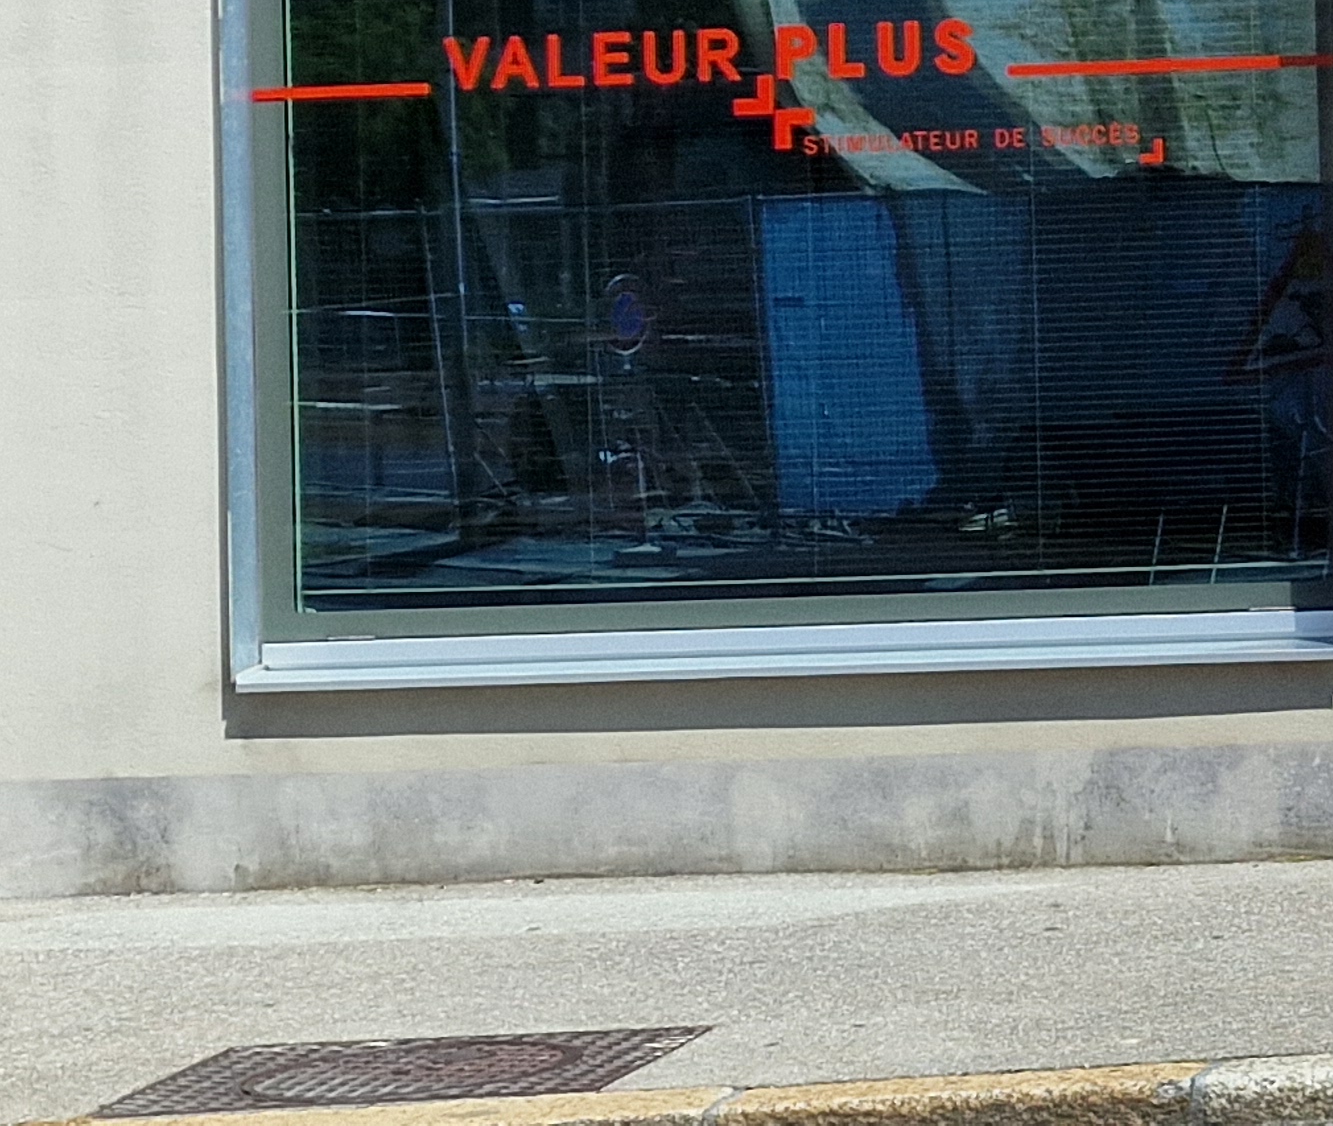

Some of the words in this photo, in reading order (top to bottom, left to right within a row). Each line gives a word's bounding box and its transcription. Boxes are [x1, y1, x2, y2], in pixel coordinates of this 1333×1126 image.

[442, 27, 742, 91] VALEUR
[775, 17, 977, 80] PLUS
[803, 129, 980, 156] STIMULATEUR
[994, 127, 1026, 149] DE
